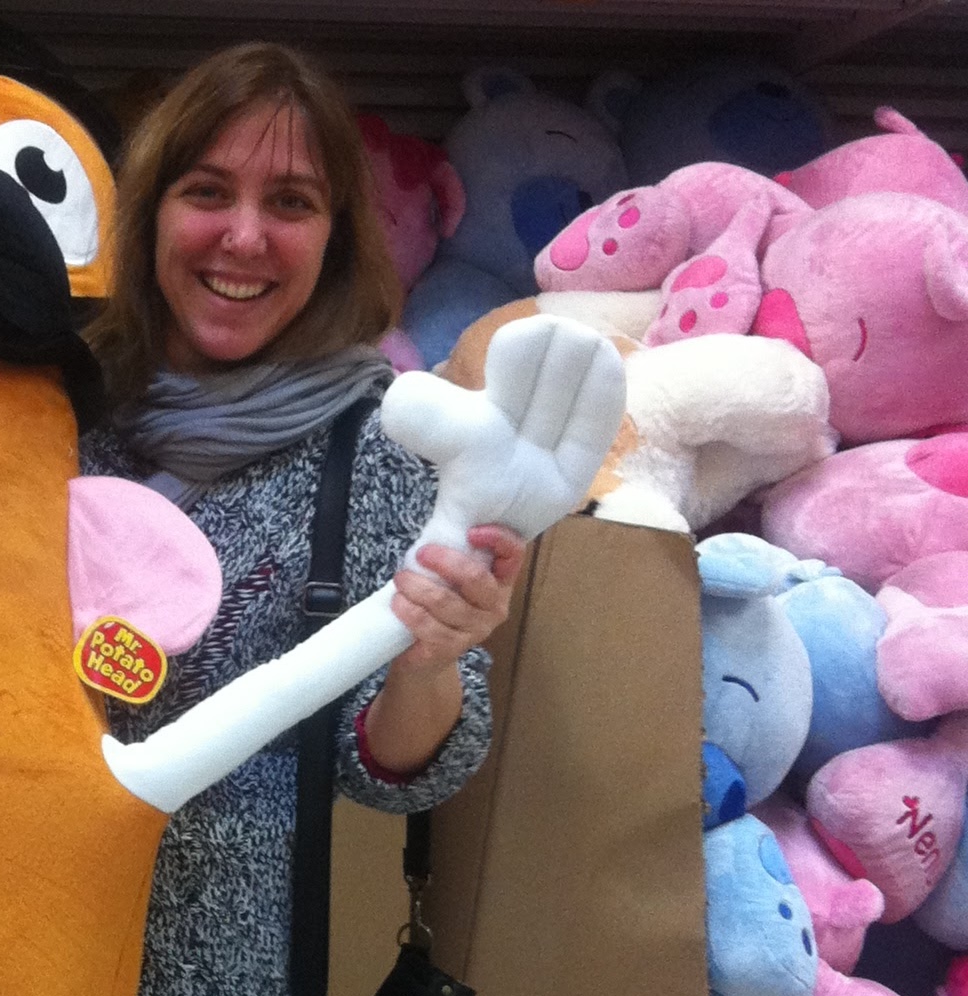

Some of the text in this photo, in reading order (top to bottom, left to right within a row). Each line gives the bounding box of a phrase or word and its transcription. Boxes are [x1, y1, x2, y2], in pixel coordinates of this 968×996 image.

[87, 651, 142, 694] Head
[90, 630, 154, 682] Potato
[896, 807, 940, 880] Nen
